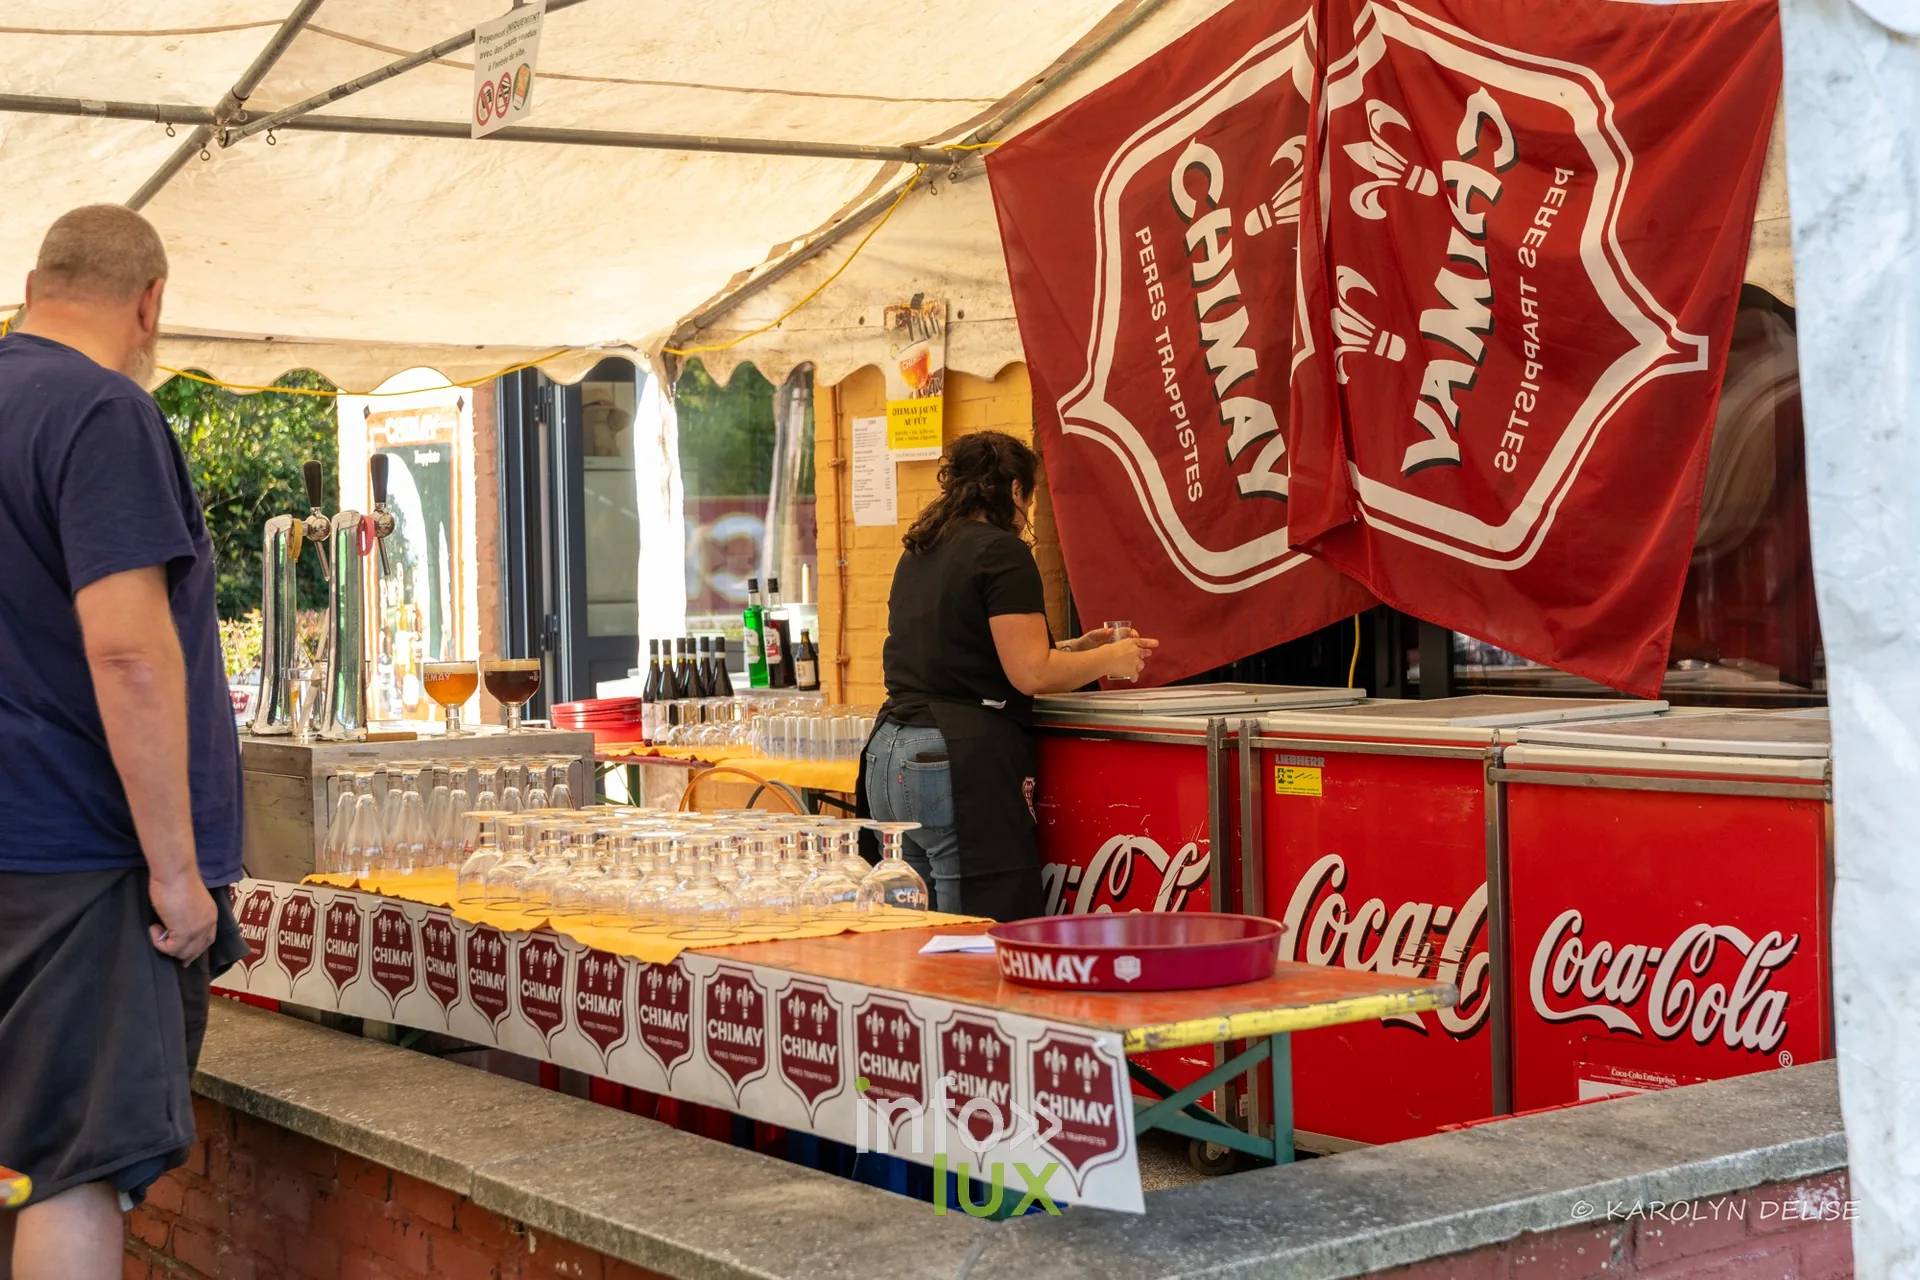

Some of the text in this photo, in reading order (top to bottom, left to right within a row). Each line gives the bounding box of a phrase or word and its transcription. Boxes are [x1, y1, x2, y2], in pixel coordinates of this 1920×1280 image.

[1170, 136, 1289, 499] CHIMAY
[1135, 225, 1203, 502] PERES TRAPPISTES
[279, 929, 313, 950] CHIMAY
[325, 937, 359, 959] CHIMAY
[373, 945, 413, 967] CHIMAY
[425, 955, 457, 979] CHIMAY
[1000, 949, 1099, 984] CHIMAY
[469, 967, 506, 991] CHIMAY
[521, 979, 562, 1004] CHIMAY
[1529, 908, 1799, 1051] Coca-Cola
[577, 991, 622, 1018] CHIMAY
[639, 1004, 689, 1033] CHIMAY
[707, 1018, 764, 1048] CHIMAY
[781, 1034, 838, 1065] CHIMAY
[860, 1051, 920, 1084] CHIMAY
[1611, 1066, 1643, 1080] Coca-Cola
[1643, 1072, 1677, 1086] Enterprises
[946, 1069, 1010, 1106] CHIMAY
[1035, 1090, 1114, 1128] CHIMAY
